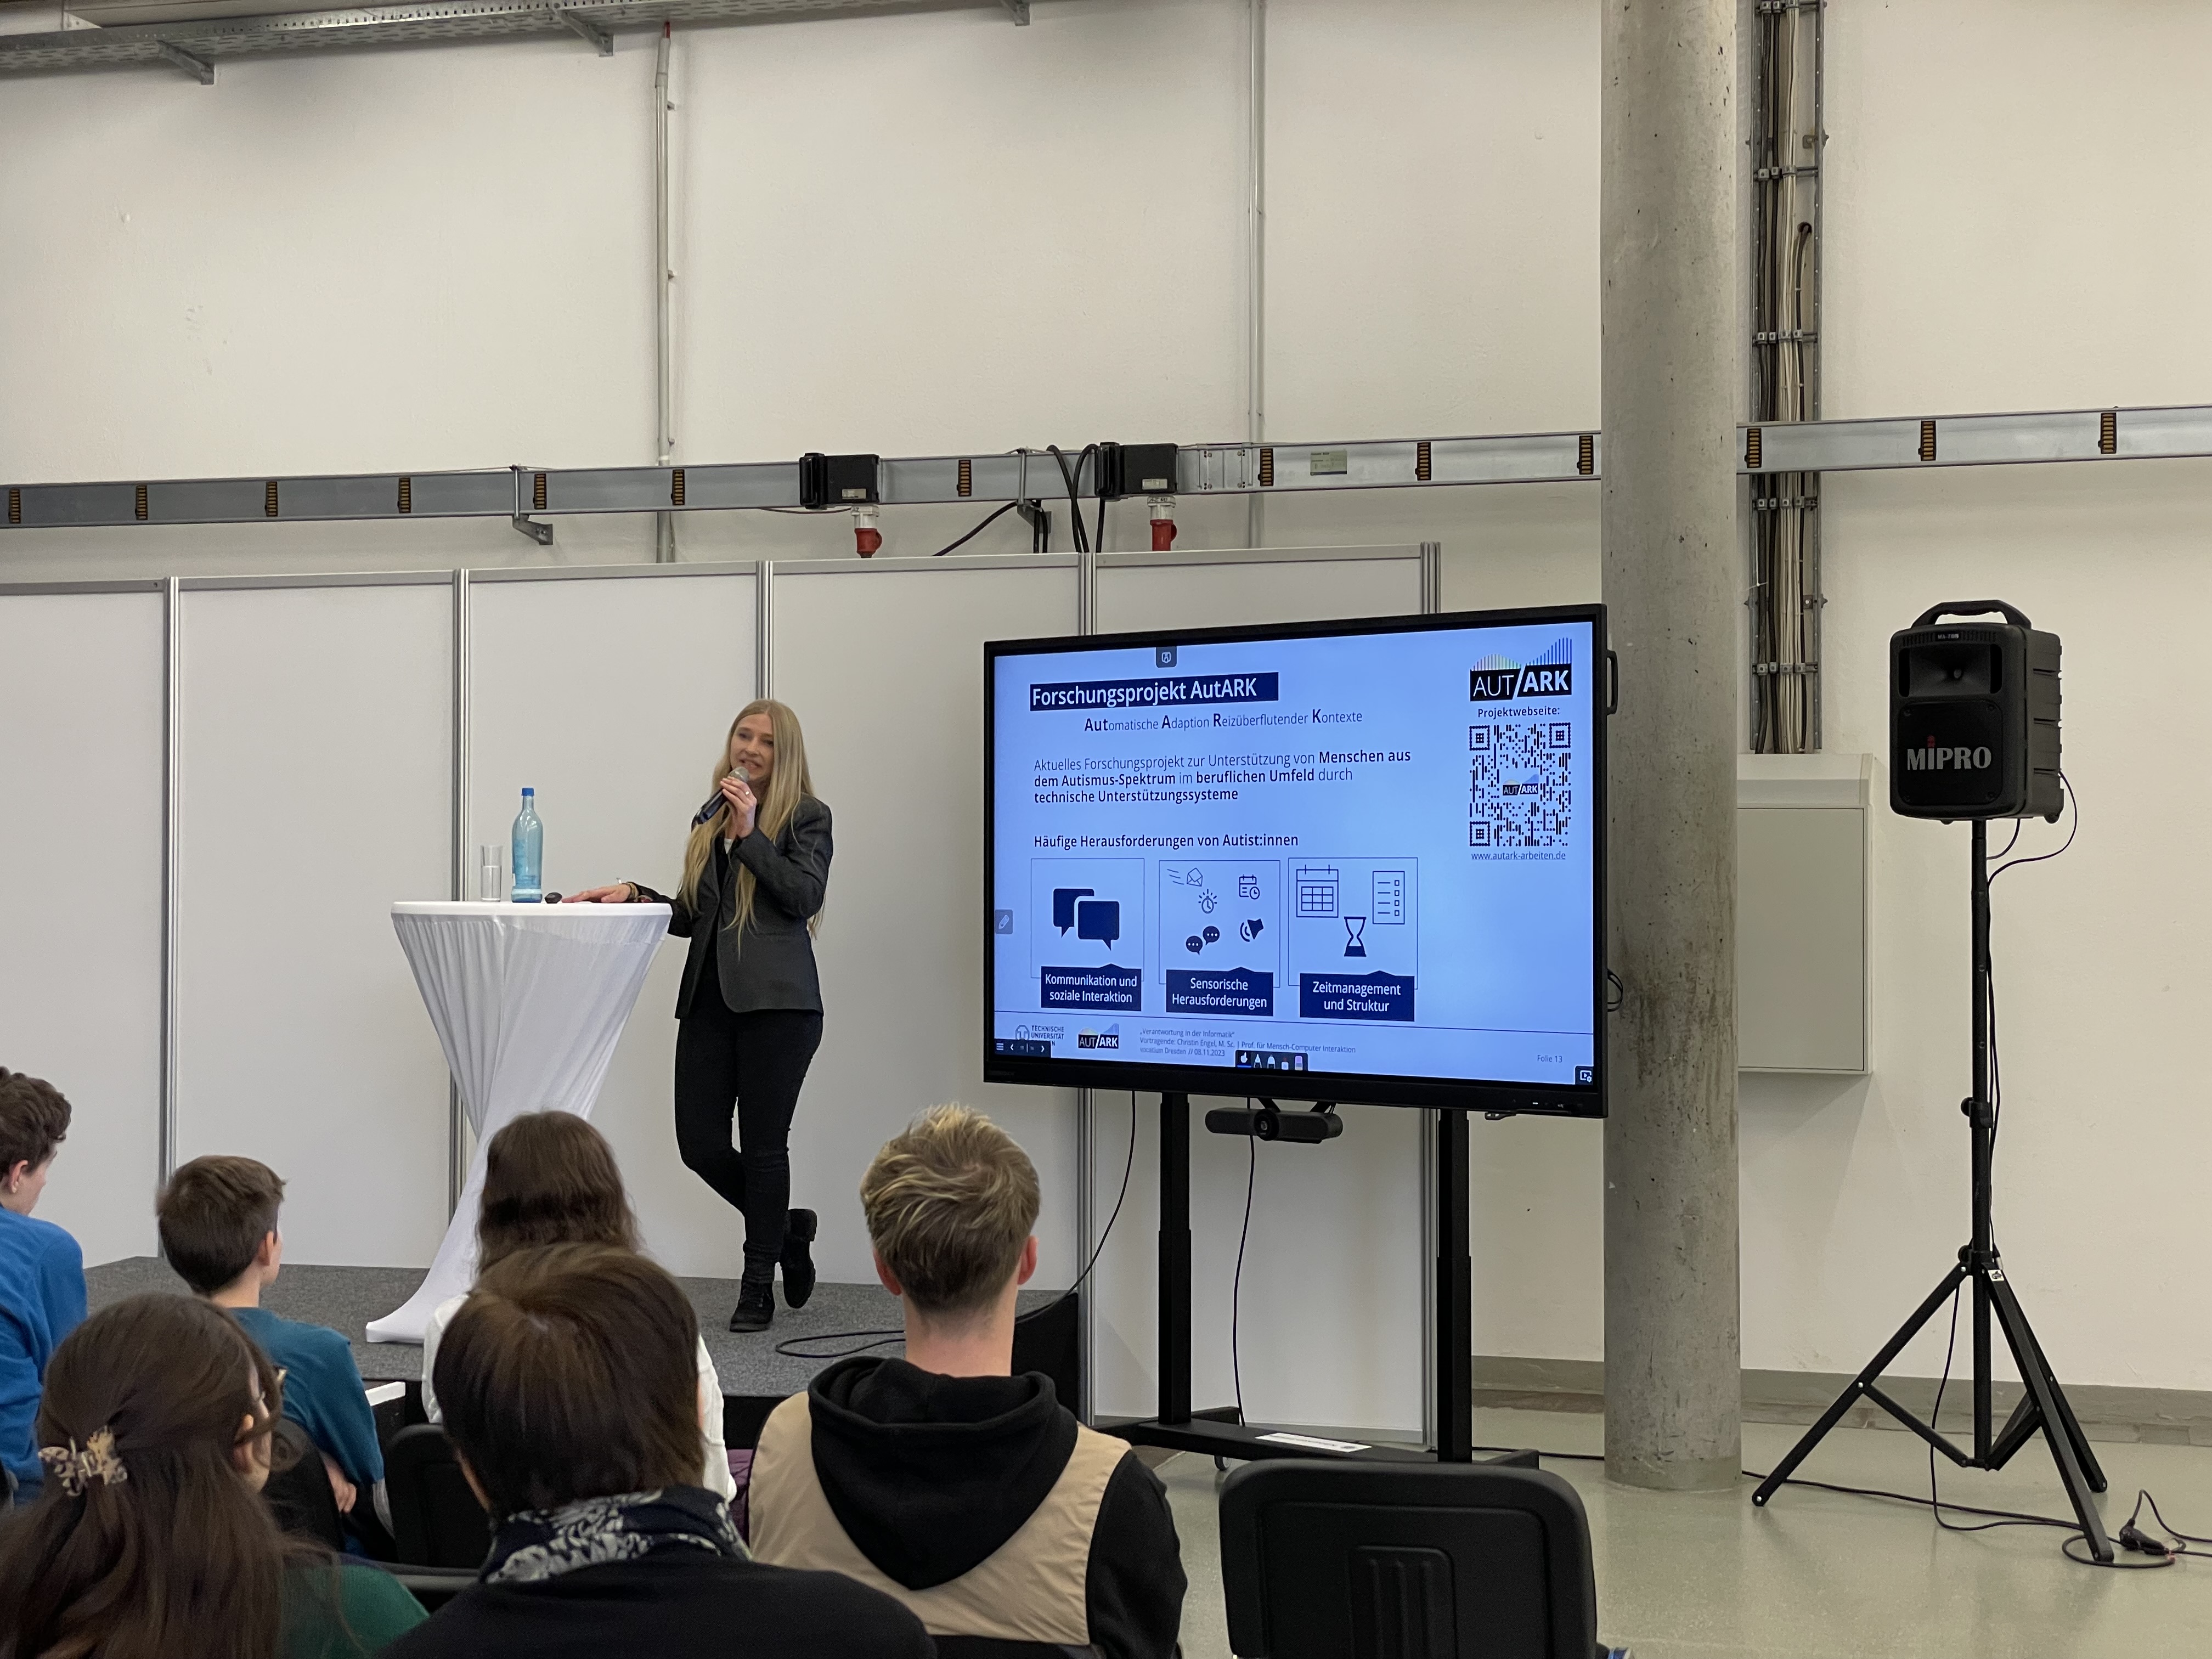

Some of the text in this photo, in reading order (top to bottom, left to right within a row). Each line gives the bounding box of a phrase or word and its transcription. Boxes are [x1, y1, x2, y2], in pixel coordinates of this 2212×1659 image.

[1032, 678, 1257, 708] Forschungsprojekt AutARK
[1084, 709, 1363, 732] Automatische Adaption Reizüberflutender Kontexte
[1477, 706, 1560, 720] Projektwebseite:
[1034, 750, 1411, 772] Aktuelles Forschungsprojekt zur Unterstützung von Menschen aus
[1034, 768, 1353, 789] dem Autismus-Spektrum im beruflichen Umfeld durch
[1034, 789, 1239, 804] technische Unterstützungssysteme
[1034, 833, 1299, 851] Häufige Herausforderungen von Autist:innen
[1471, 851, 1566, 861] www.autark-arbeiten.de
[1045, 973, 1138, 988] Kommunikation und
[1190, 978, 1249, 991] Sensorische
[1049, 989, 1133, 1003] soziale Interaktion
[1312, 981, 1402, 998] Zeitmanagement
[1172, 993, 1268, 1011] Herausforderungen
[1323, 998, 1390, 1012] und Struktur
[1139, 1037, 1176, 1046] Vortragende:
[1200, 1039, 1217, 1048] Engel,
[1267, 1042, 1322, 1052] Mensch-Computer
[1537, 1054, 1553, 1063] Folie
